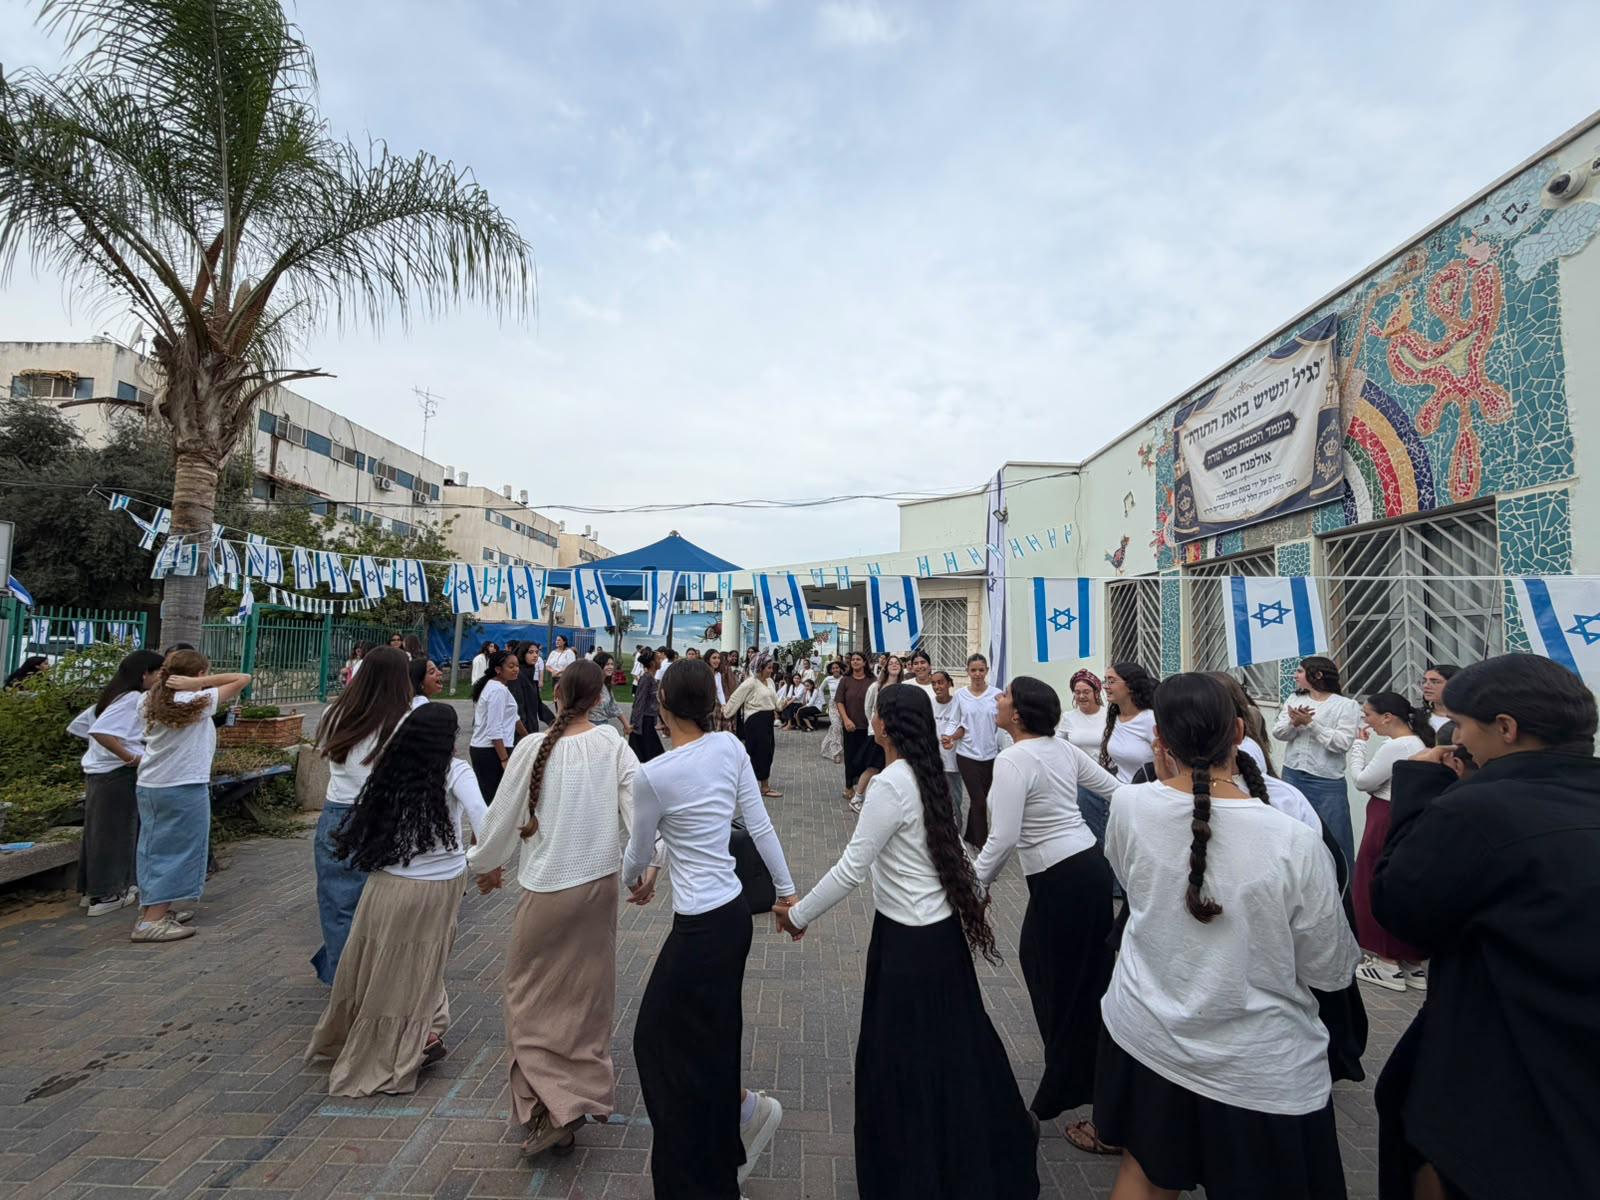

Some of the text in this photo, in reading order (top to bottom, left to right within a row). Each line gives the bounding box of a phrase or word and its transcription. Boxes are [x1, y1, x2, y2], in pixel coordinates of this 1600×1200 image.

[1253, 378, 1290, 411] ונשיש
[1221, 400, 1250, 429] בזאת
[1264, 418, 1291, 438] מעמד
[1223, 443, 1238, 456] ספר
[1239, 431, 1264, 450] הכנסת
[1239, 451, 1272, 474] אולפנת
[1251, 481, 1259, 489] ידי
[1259, 478, 1267, 486] על
